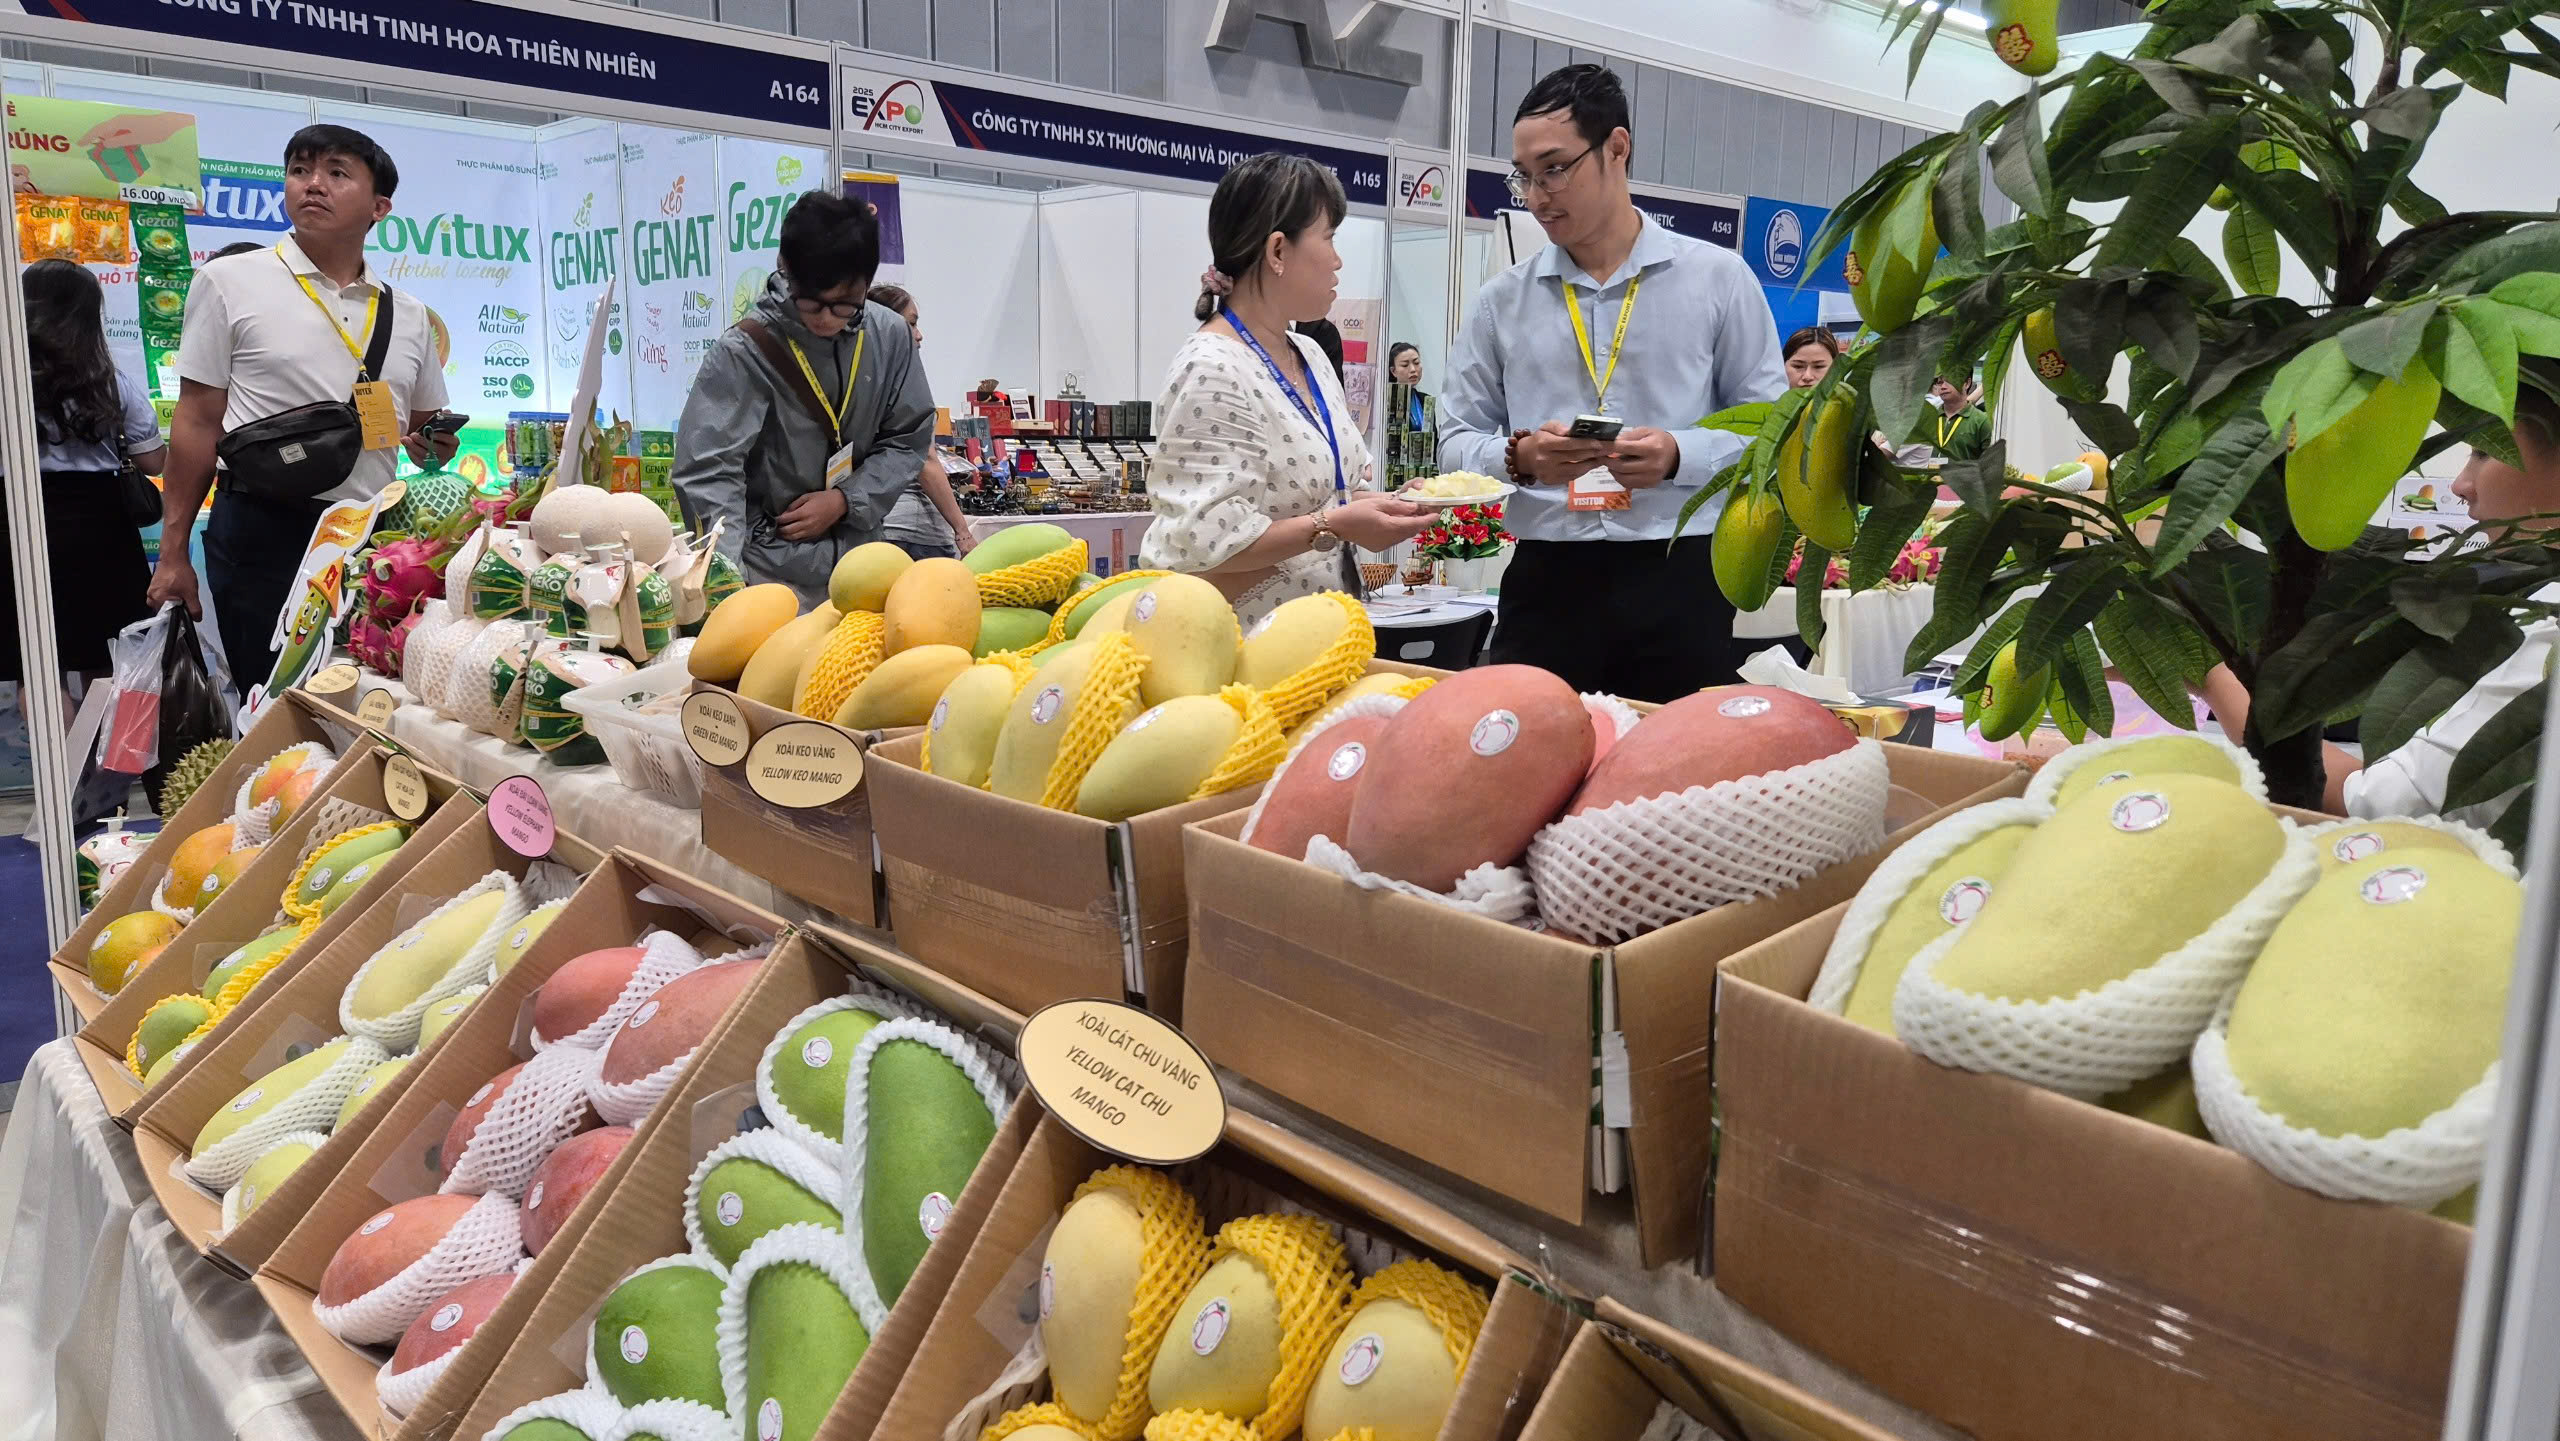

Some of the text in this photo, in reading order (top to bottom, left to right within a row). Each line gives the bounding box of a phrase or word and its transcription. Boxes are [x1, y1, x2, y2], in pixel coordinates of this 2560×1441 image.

[288, 1, 369, 35] TNHH
[373, 15, 439, 46] TINH
[445, 26, 503, 57] HOA
[506, 37, 580, 68] THIÊN
[585, 49, 657, 80] NHIÊN
[769, 79, 821, 106] A164
[852, 86, 875, 97] 2025
[971, 108, 1018, 134] CÔNG
[1019, 118, 1040, 138] TY
[1041, 121, 1084, 145] TNHH
[1086, 129, 1105, 148] SX
[1106, 132, 1168, 157] THƯƠNG
[1170, 142, 1196, 166] MẠI
[1197, 143, 1215, 164] VÀ
[1352, 169, 1381, 190] A165
[121, 186, 166, 202] 16.000
[30, 205, 71, 220] GENAT
[81, 207, 122, 223] GENAT
[138, 212, 179, 228] Gezcol
[1712, 220, 1733, 235] A543
[552, 227, 619, 291] GENAT
[633, 214, 715, 287] GENAT
[682, 290, 696, 311] All
[478, 304, 501, 320] All
[682, 311, 712, 329] Natural
[478, 320, 525, 335] Natural
[484, 355, 530, 368] HACCP
[482, 376, 508, 386] ISO
[483, 389, 509, 399] GMP
[645, 464, 669, 474] GENAT
[1573, 496, 1606, 506] VISITOR
[699, 703, 713, 717] XOÀI
[712, 710, 723, 722] KEO
[692, 724, 738, 752] GREEN KEO MANGO
[775, 741, 836, 759] XOÀI KEO VÀNG
[761, 766, 843, 785] YELLOW KEO MANGO
[1076, 1010, 1201, 1090] XOÀI CÁT CHU VÀNG
[1064, 1045, 1174, 1117] YELLOW CAT CHU
[1070, 1085, 1127, 1126] MANGO
